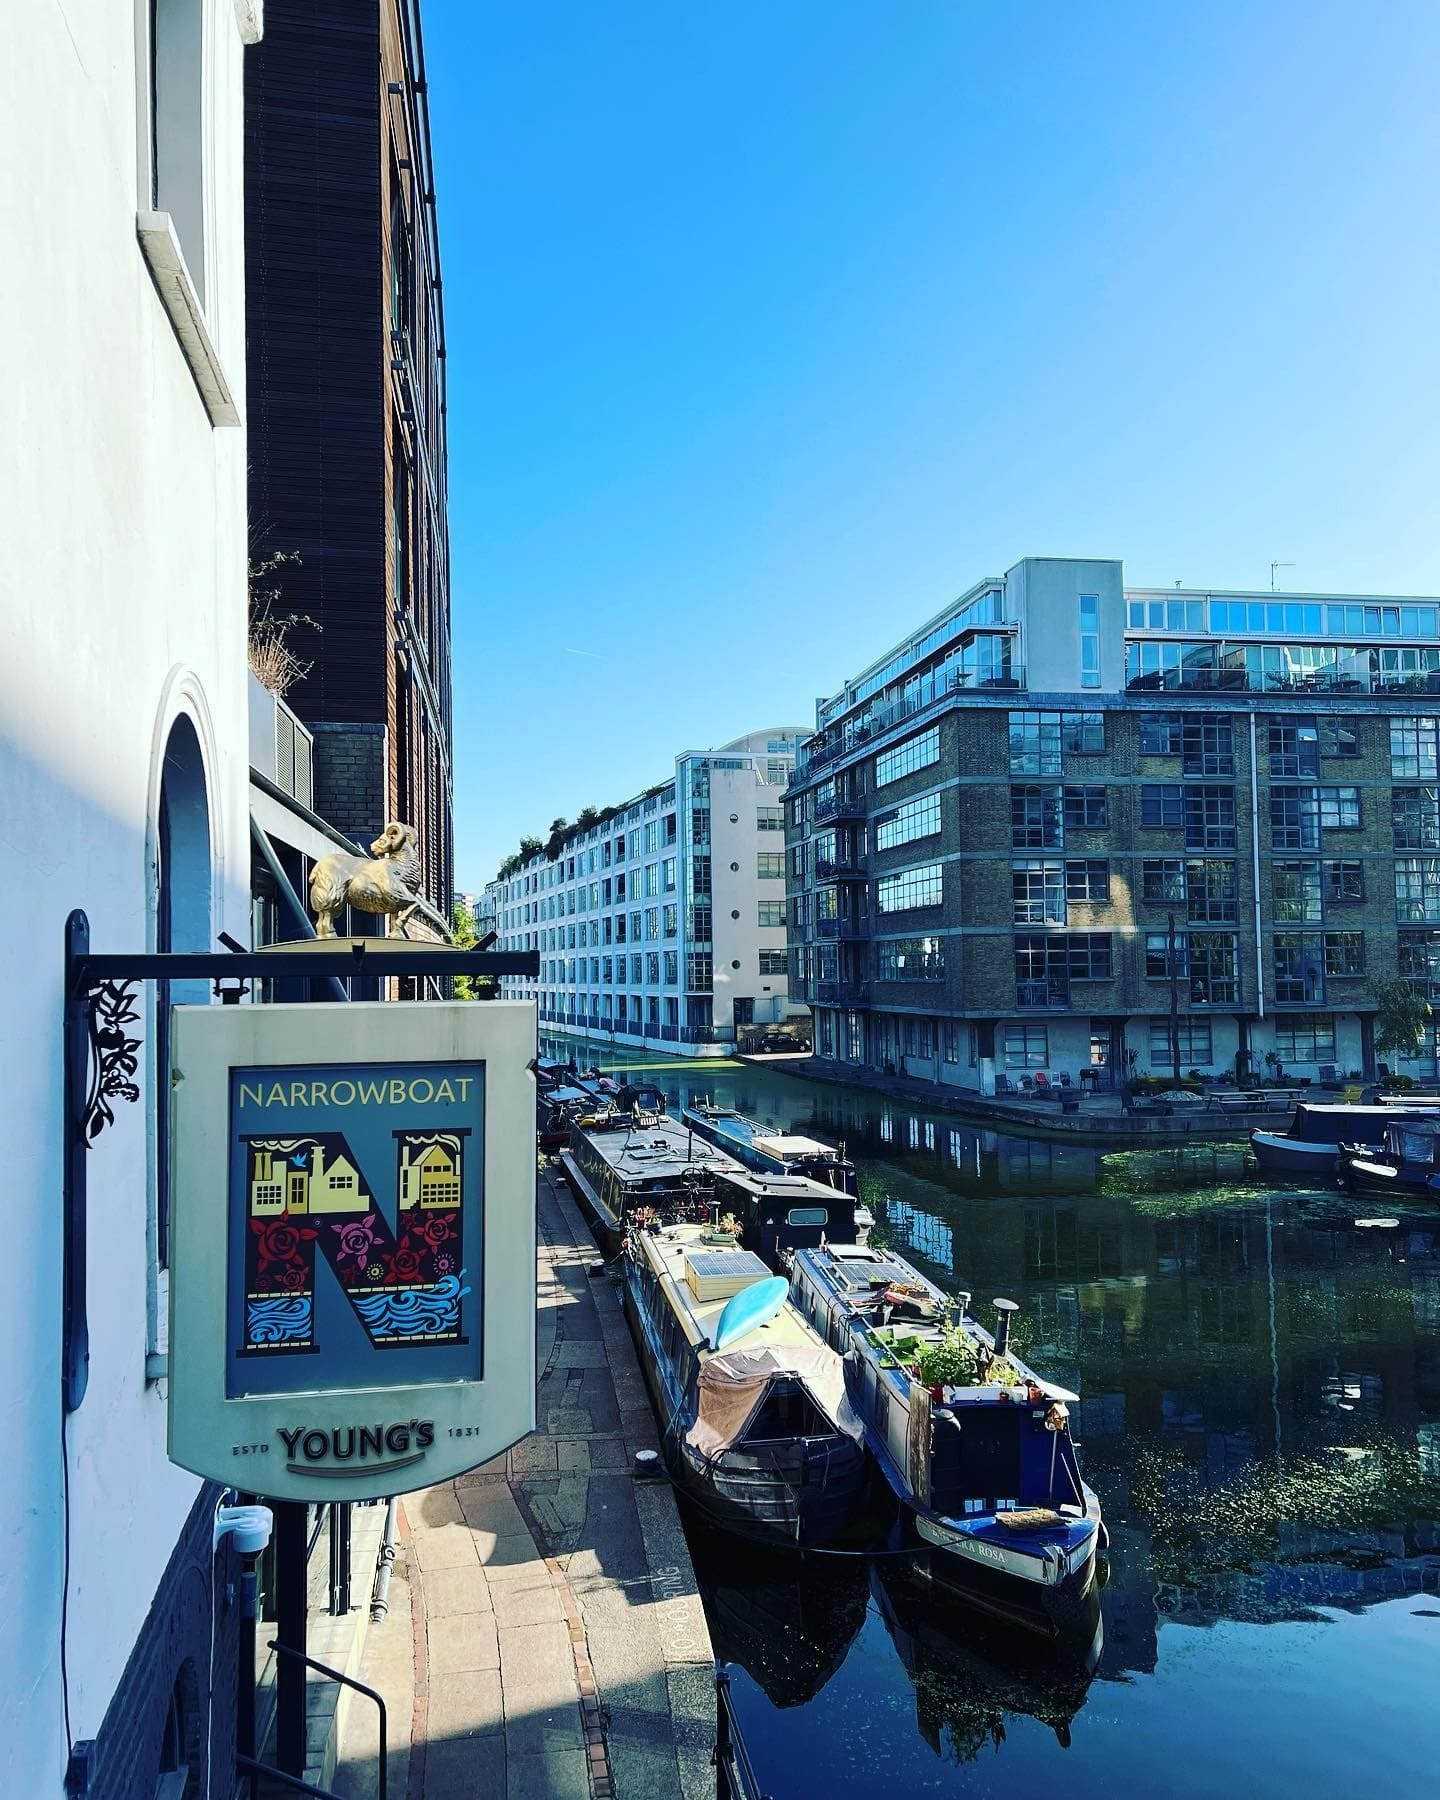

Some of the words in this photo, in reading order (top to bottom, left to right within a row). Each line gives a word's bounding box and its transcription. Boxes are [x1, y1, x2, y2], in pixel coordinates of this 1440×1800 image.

[239, 1078, 474, 1108] NARROWBOAT
[232, 1443, 269, 1456] ESTD
[276, 1418, 435, 1461] YOUNG'S
[447, 1426, 481, 1438] 1831
[979, 1546, 1006, 1563] ROSA
